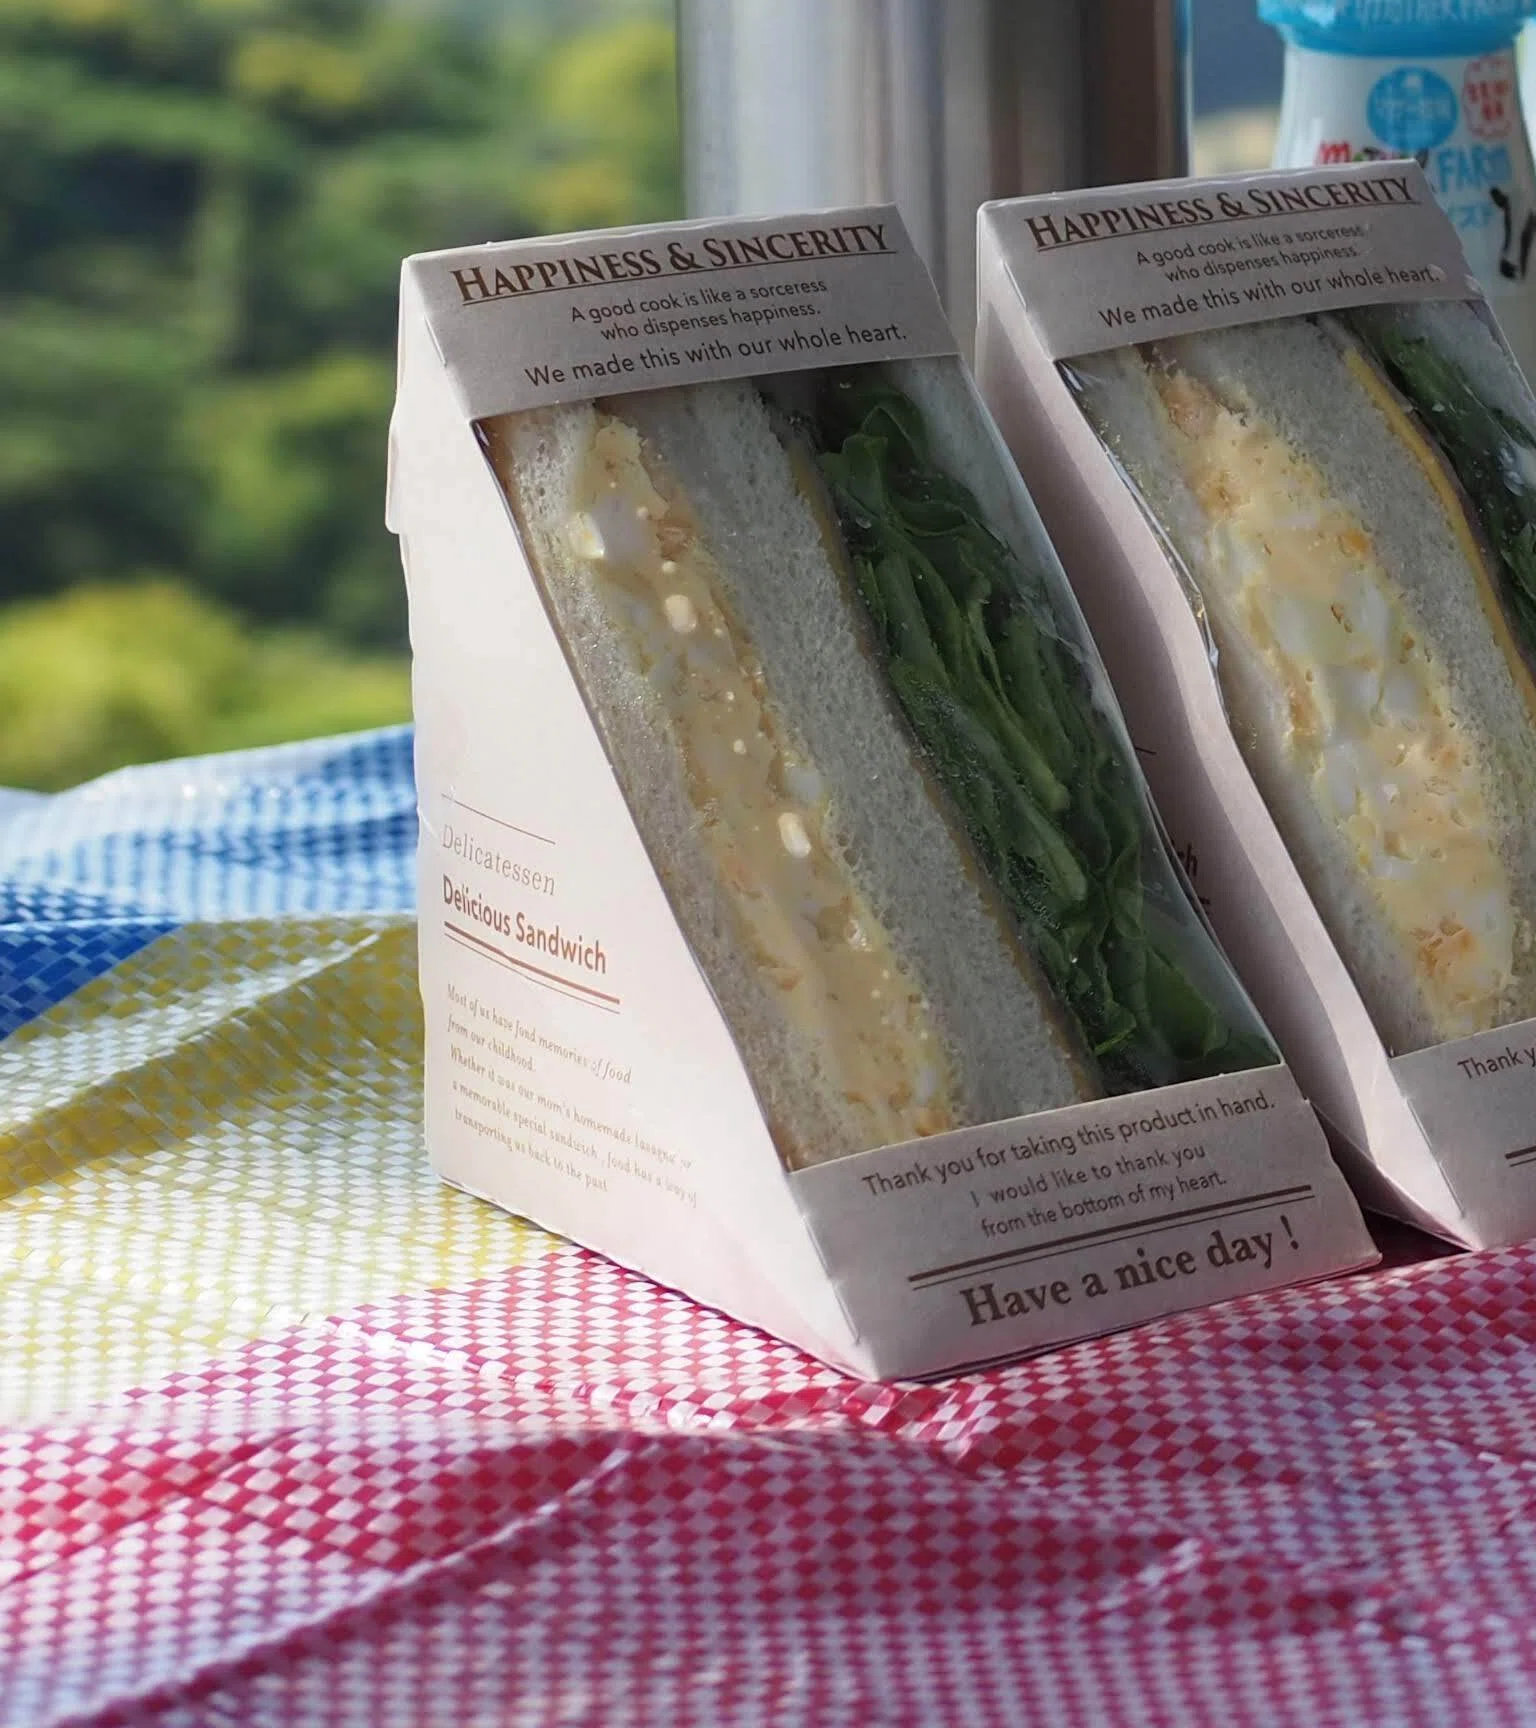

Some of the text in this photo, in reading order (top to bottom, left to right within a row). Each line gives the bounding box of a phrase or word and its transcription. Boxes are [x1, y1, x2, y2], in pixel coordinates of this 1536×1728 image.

[1024, 177, 1414, 248] HAPPINESS & SINCERITY
[450, 224, 889, 302] HAPPINESS & SINCERITY
[1136, 223, 1364, 267] A good cook is like a sorceress
[1165, 265, 1201, 283] who
[1203, 254, 1280, 278] dispenses
[571, 279, 827, 324] A good cook is like a sorceress
[601, 303, 821, 341] who dispenses happiness.
[1099, 263, 1440, 329] We made this with our whole heart.
[524, 323, 907, 387] We made this with our whole heart.
[442, 823, 556, 896] Delicatessen
[442, 873, 606, 974] Delicious Sandwich
[448, 1013, 468, 1038] from
[470, 1031, 485, 1046] our
[539, 1036, 588, 1068] memories
[602, 1060, 632, 1084] food
[451, 1043, 485, 1076] Whether
[518, 1084, 534, 1101] our
[1457, 1047, 1524, 1080] Thank
[454, 1107, 513, 1152] transporting
[459, 1083, 511, 1119] memorable
[862, 1090, 1275, 1197] Thank you for taking this product in hand.
[970, 1143, 1206, 1208] I would like to thank you
[981, 1170, 1227, 1239] from the bottom of my heart.
[959, 1279, 1073, 1326] Have
[1081, 1268, 1108, 1299] a
[1113, 1246, 1197, 1292] nice
[1206, 1229, 1273, 1270] day
